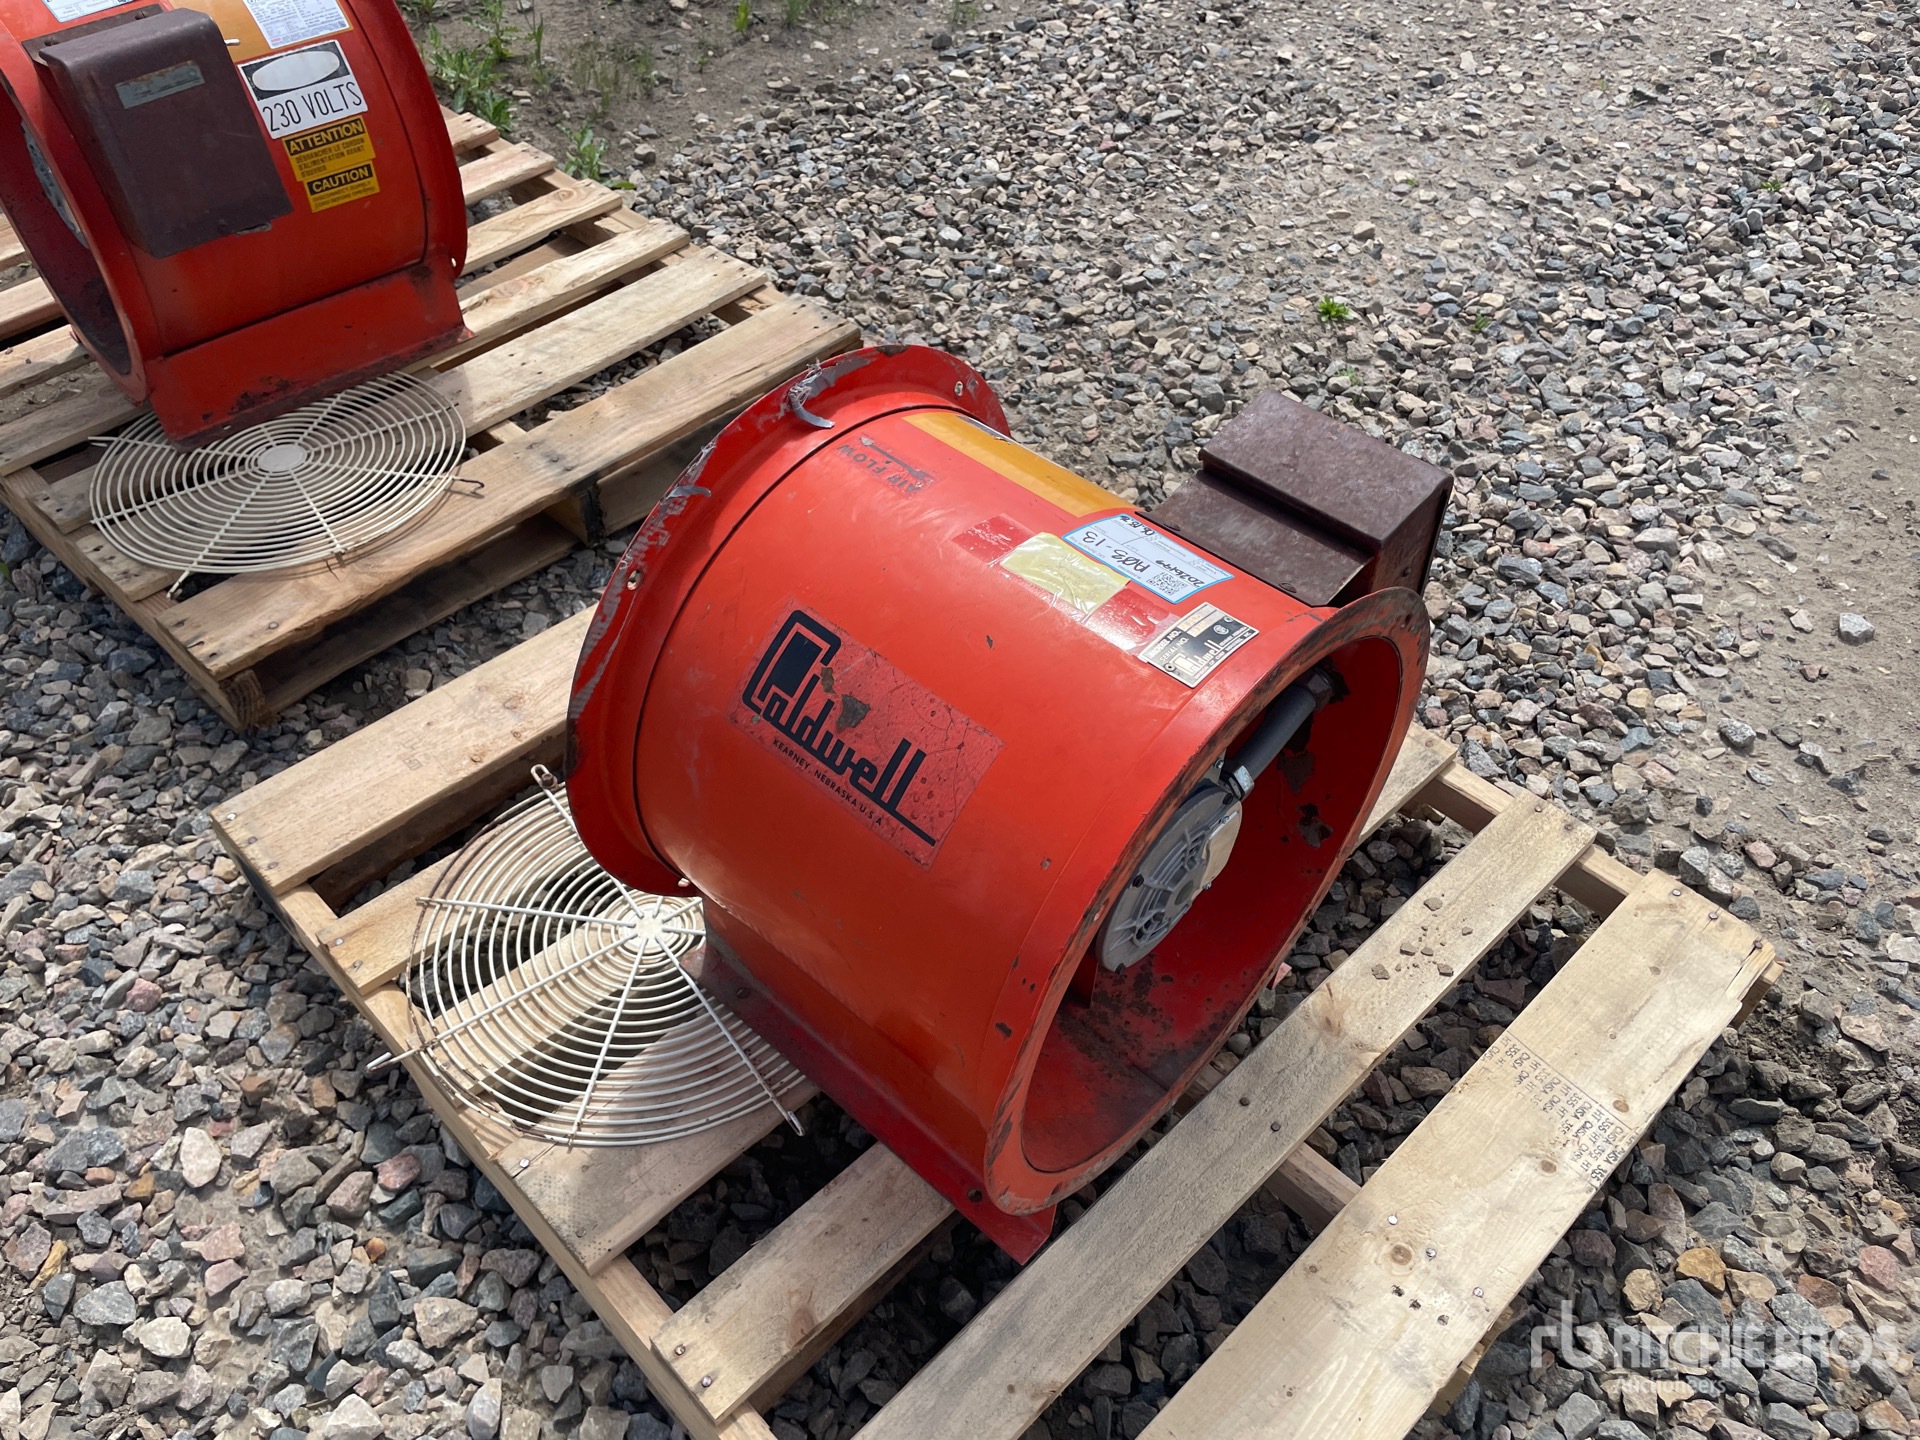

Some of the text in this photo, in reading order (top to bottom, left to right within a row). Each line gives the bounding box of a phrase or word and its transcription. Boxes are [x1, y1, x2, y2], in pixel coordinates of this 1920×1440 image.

[262, 81, 363, 132] 230 VOLTS
[289, 120, 364, 153] ATTENTION
[312, 167, 369, 192] CAUTION
[837, 444, 922, 493] AIR FLOW
[1166, 630, 1183, 641] NO.
[1160, 637, 1190, 662] SERIAL NO.
[742, 610, 935, 846] Caldwell
[814, 770, 857, 807] NEBRASKA
[1505, 1044, 1520, 1058] 355
[1511, 1052, 1530, 1070] CMSA
[1529, 1060, 1541, 1072] HT
[1525, 1068, 1551, 1093] 355 HT
[1541, 1076, 1561, 1094] CMSA
[1560, 1084, 1573, 1096] HT
[1542, 1095, 1561, 1113] CMSA
[1556, 1093, 1582, 1119] 355 HT
[1558, 1101, 1593, 1135] CMSA 355
[1572, 1109, 1605, 1138] HT CMSA
[1598, 1118, 1614, 1133] 355
[1580, 1126, 1623, 1172] CMSA 355 HT
[1589, 1132, 1600, 1145] HT
[1591, 1165, 1608, 1181] 355
